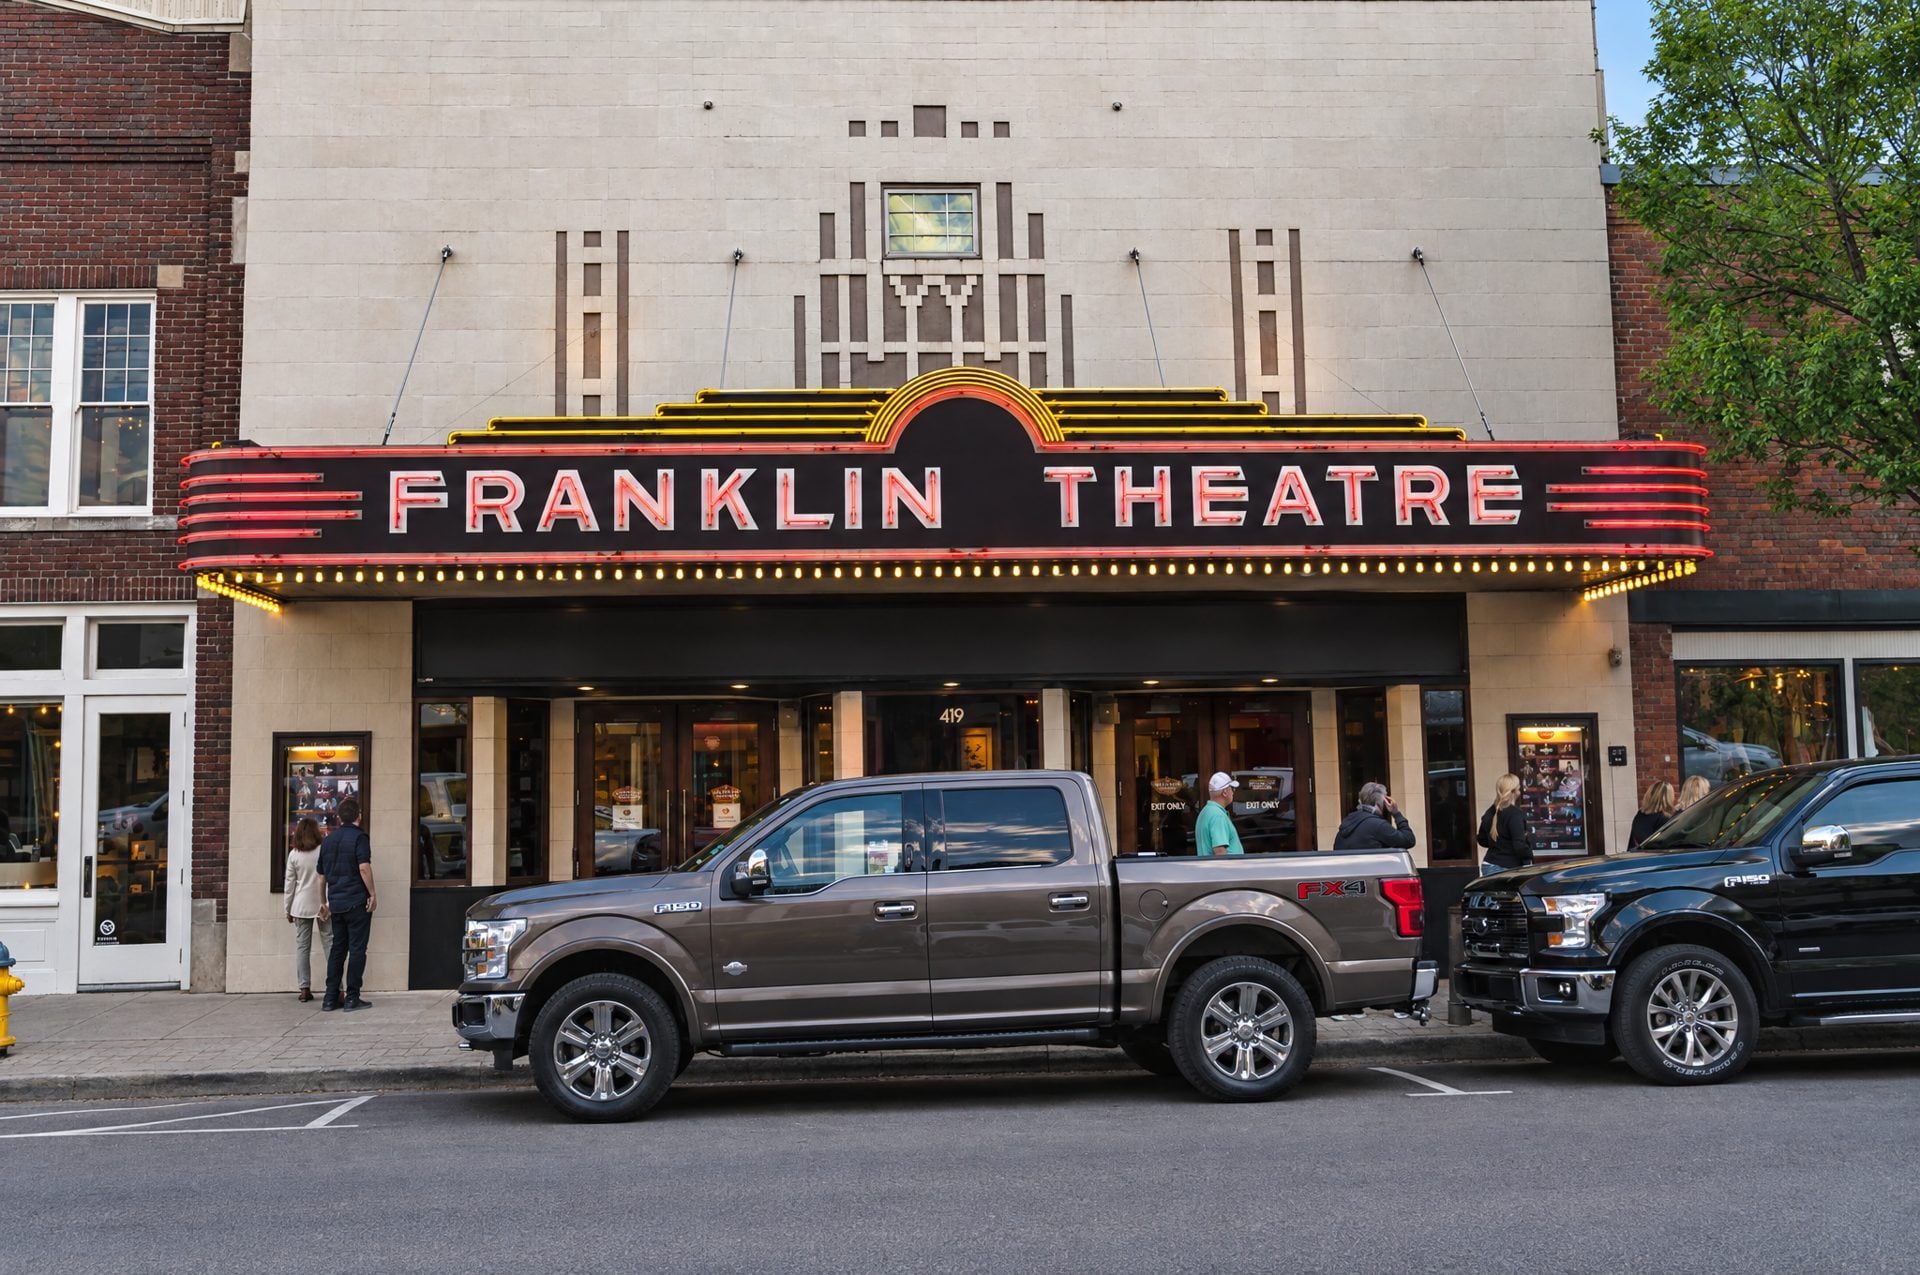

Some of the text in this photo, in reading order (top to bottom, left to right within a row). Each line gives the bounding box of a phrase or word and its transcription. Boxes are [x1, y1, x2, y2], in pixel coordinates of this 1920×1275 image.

[388, 464, 1523, 534] FRANKLIN THEATRE
[939, 708, 965, 723] 419
[1151, 802, 1186, 811] EXIT ONLY
[1246, 801, 1280, 809] EXIT ONLY
[1296, 880, 1367, 900] FX4
